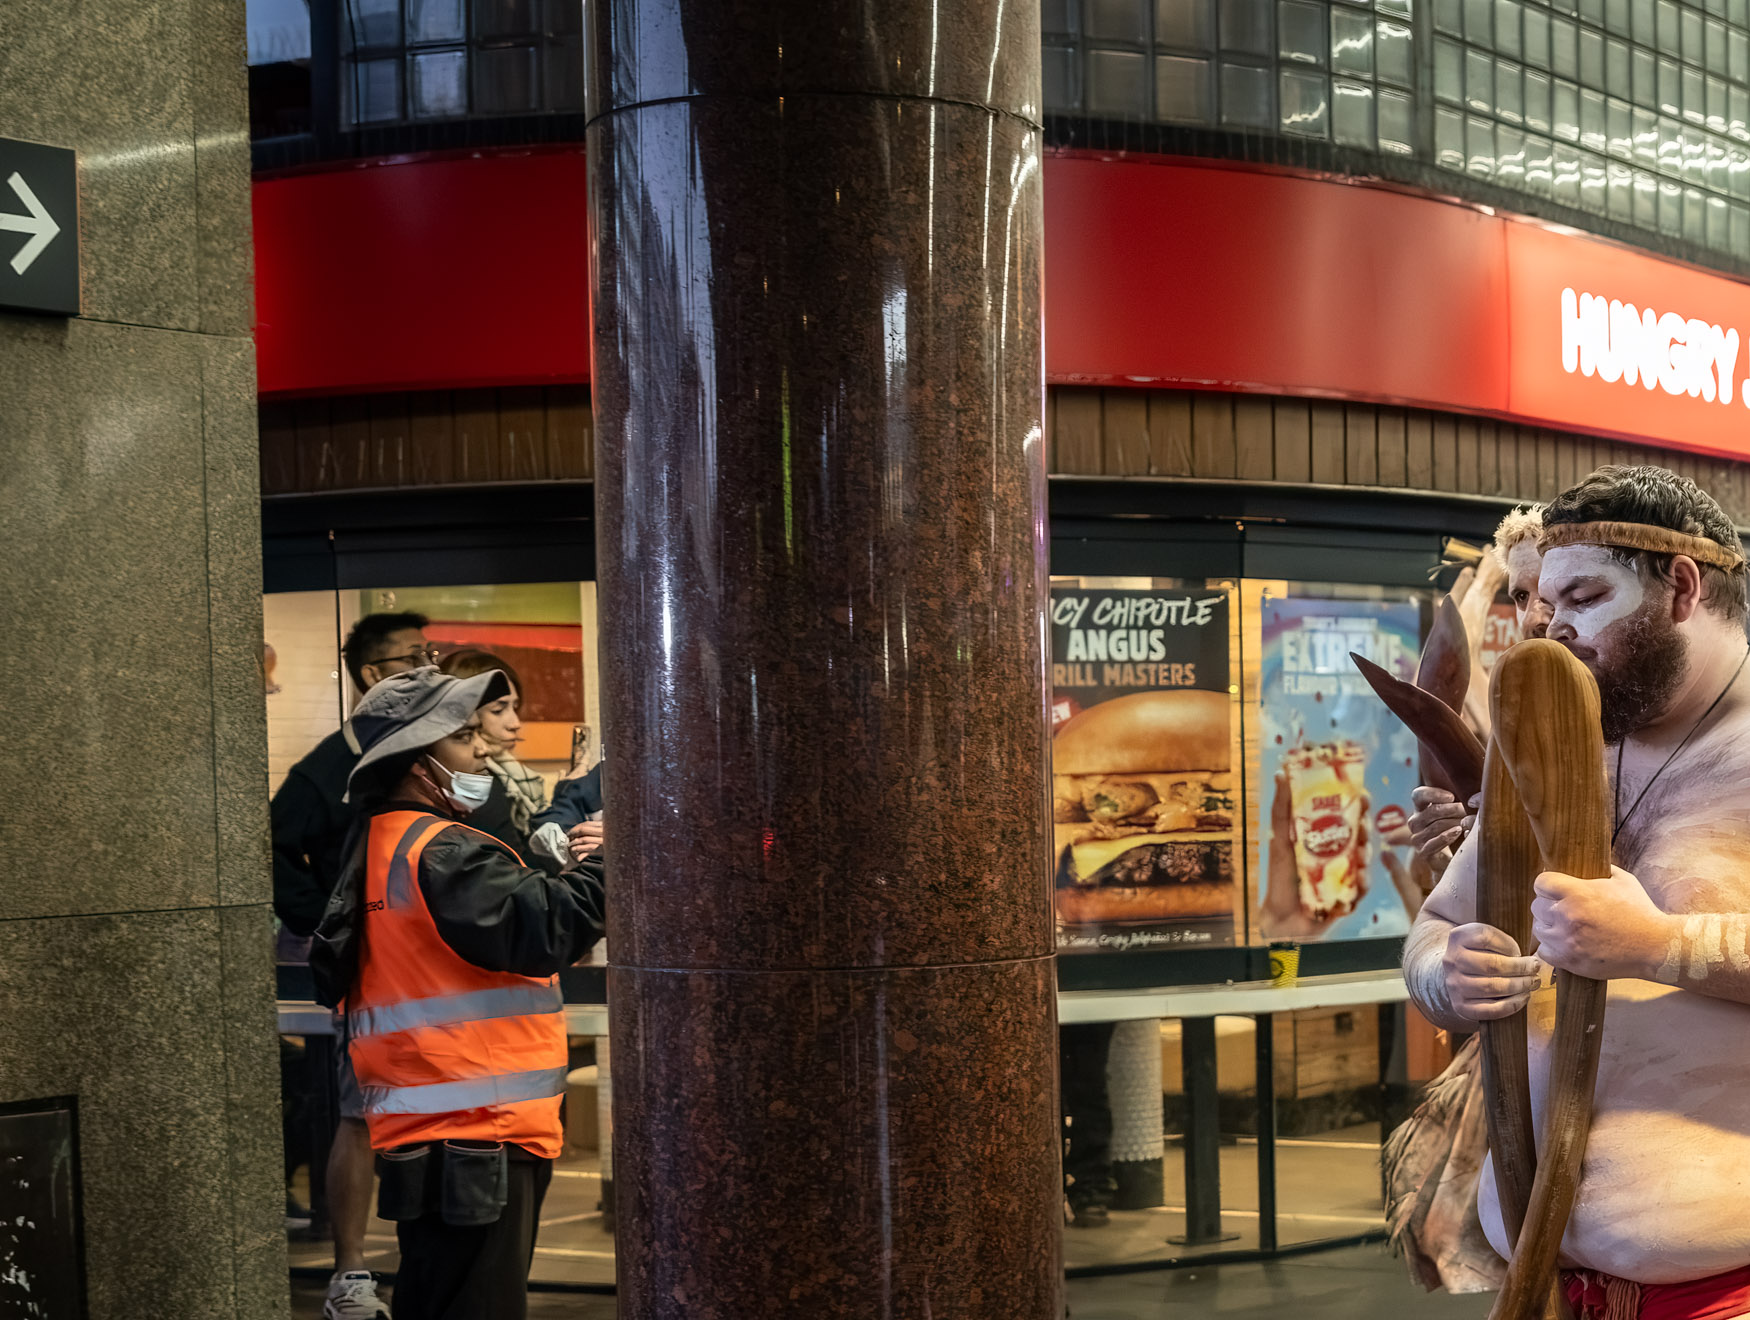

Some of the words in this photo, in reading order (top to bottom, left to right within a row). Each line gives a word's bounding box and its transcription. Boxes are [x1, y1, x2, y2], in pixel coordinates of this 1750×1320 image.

[1561, 287, 1740, 405] HUNGRY
[1092, 594, 1225, 627] CHIPOTLE
[1067, 629, 1167, 662] ANGUS
[1052, 664, 1098, 687] RILL
[1103, 663, 1197, 686] MASTERS
